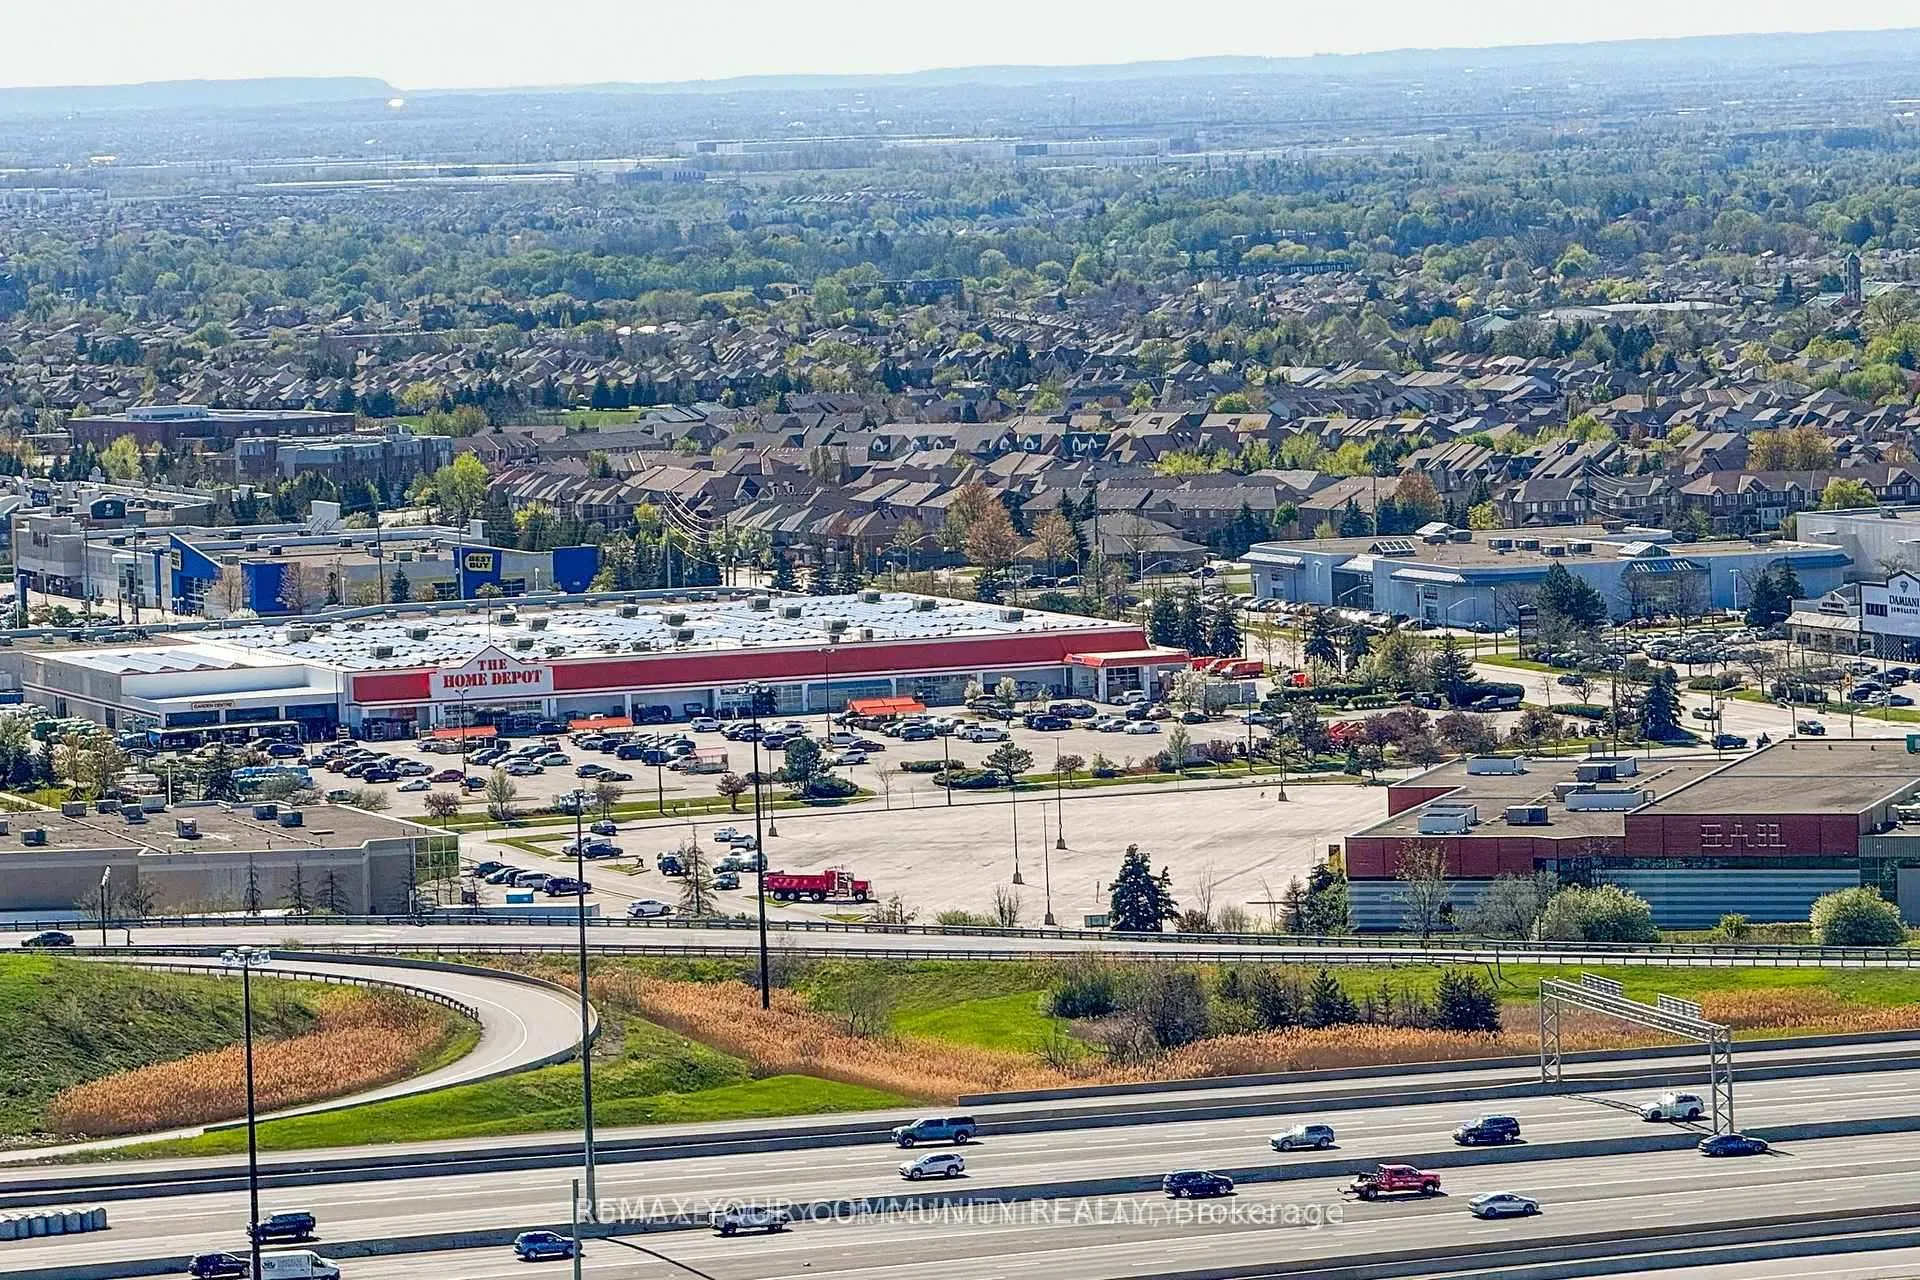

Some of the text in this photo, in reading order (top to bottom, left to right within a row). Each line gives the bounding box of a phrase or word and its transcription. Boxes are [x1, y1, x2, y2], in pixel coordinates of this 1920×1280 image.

[469, 554, 492, 562] BEST
[1889, 595, 1920, 608] DAMIANI
[477, 659, 508, 671] THE
[443, 670, 543, 688] HOME DEPOT
